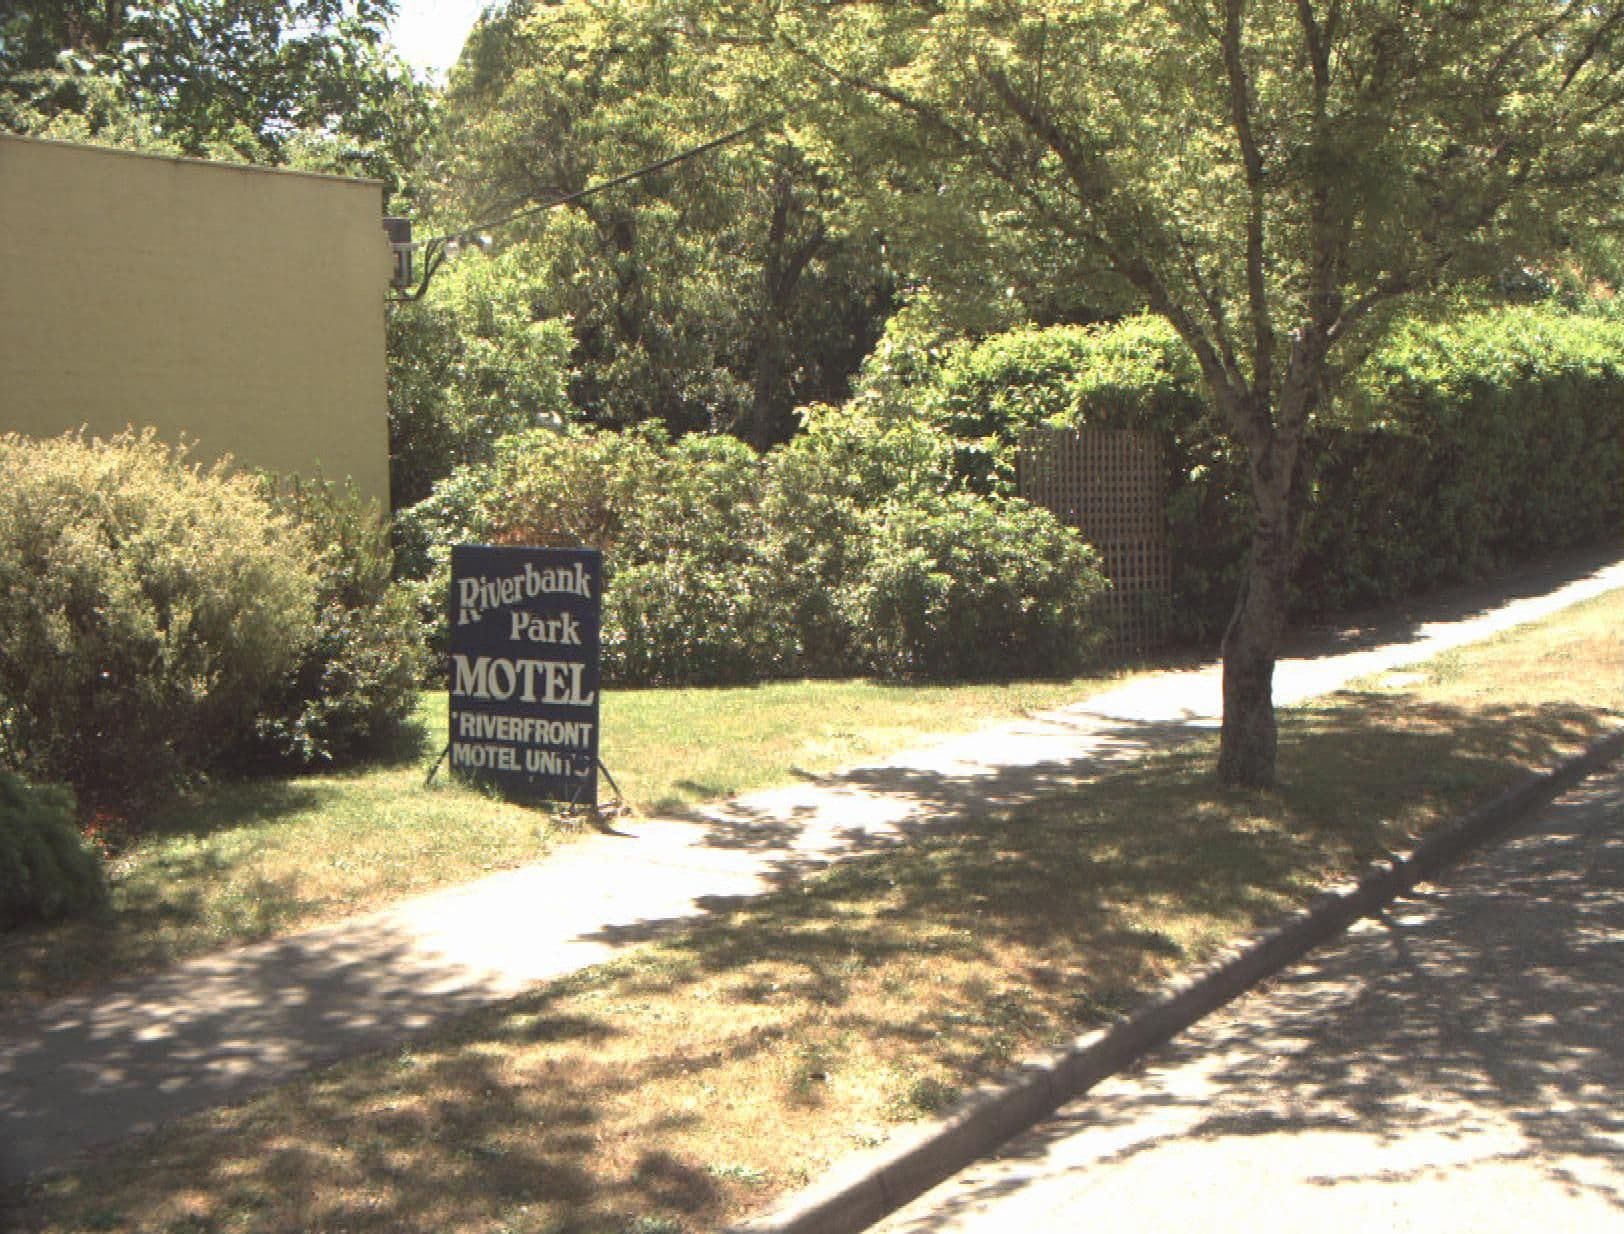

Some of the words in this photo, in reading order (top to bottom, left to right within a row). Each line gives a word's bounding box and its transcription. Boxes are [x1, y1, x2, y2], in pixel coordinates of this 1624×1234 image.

[457, 562, 591, 625] Riverbank
[510, 611, 582, 645] Park
[452, 655, 594, 706] MOTEL
[459, 711, 592, 748] RIVERFRONT
[452, 743, 521, 771] MOTEL
